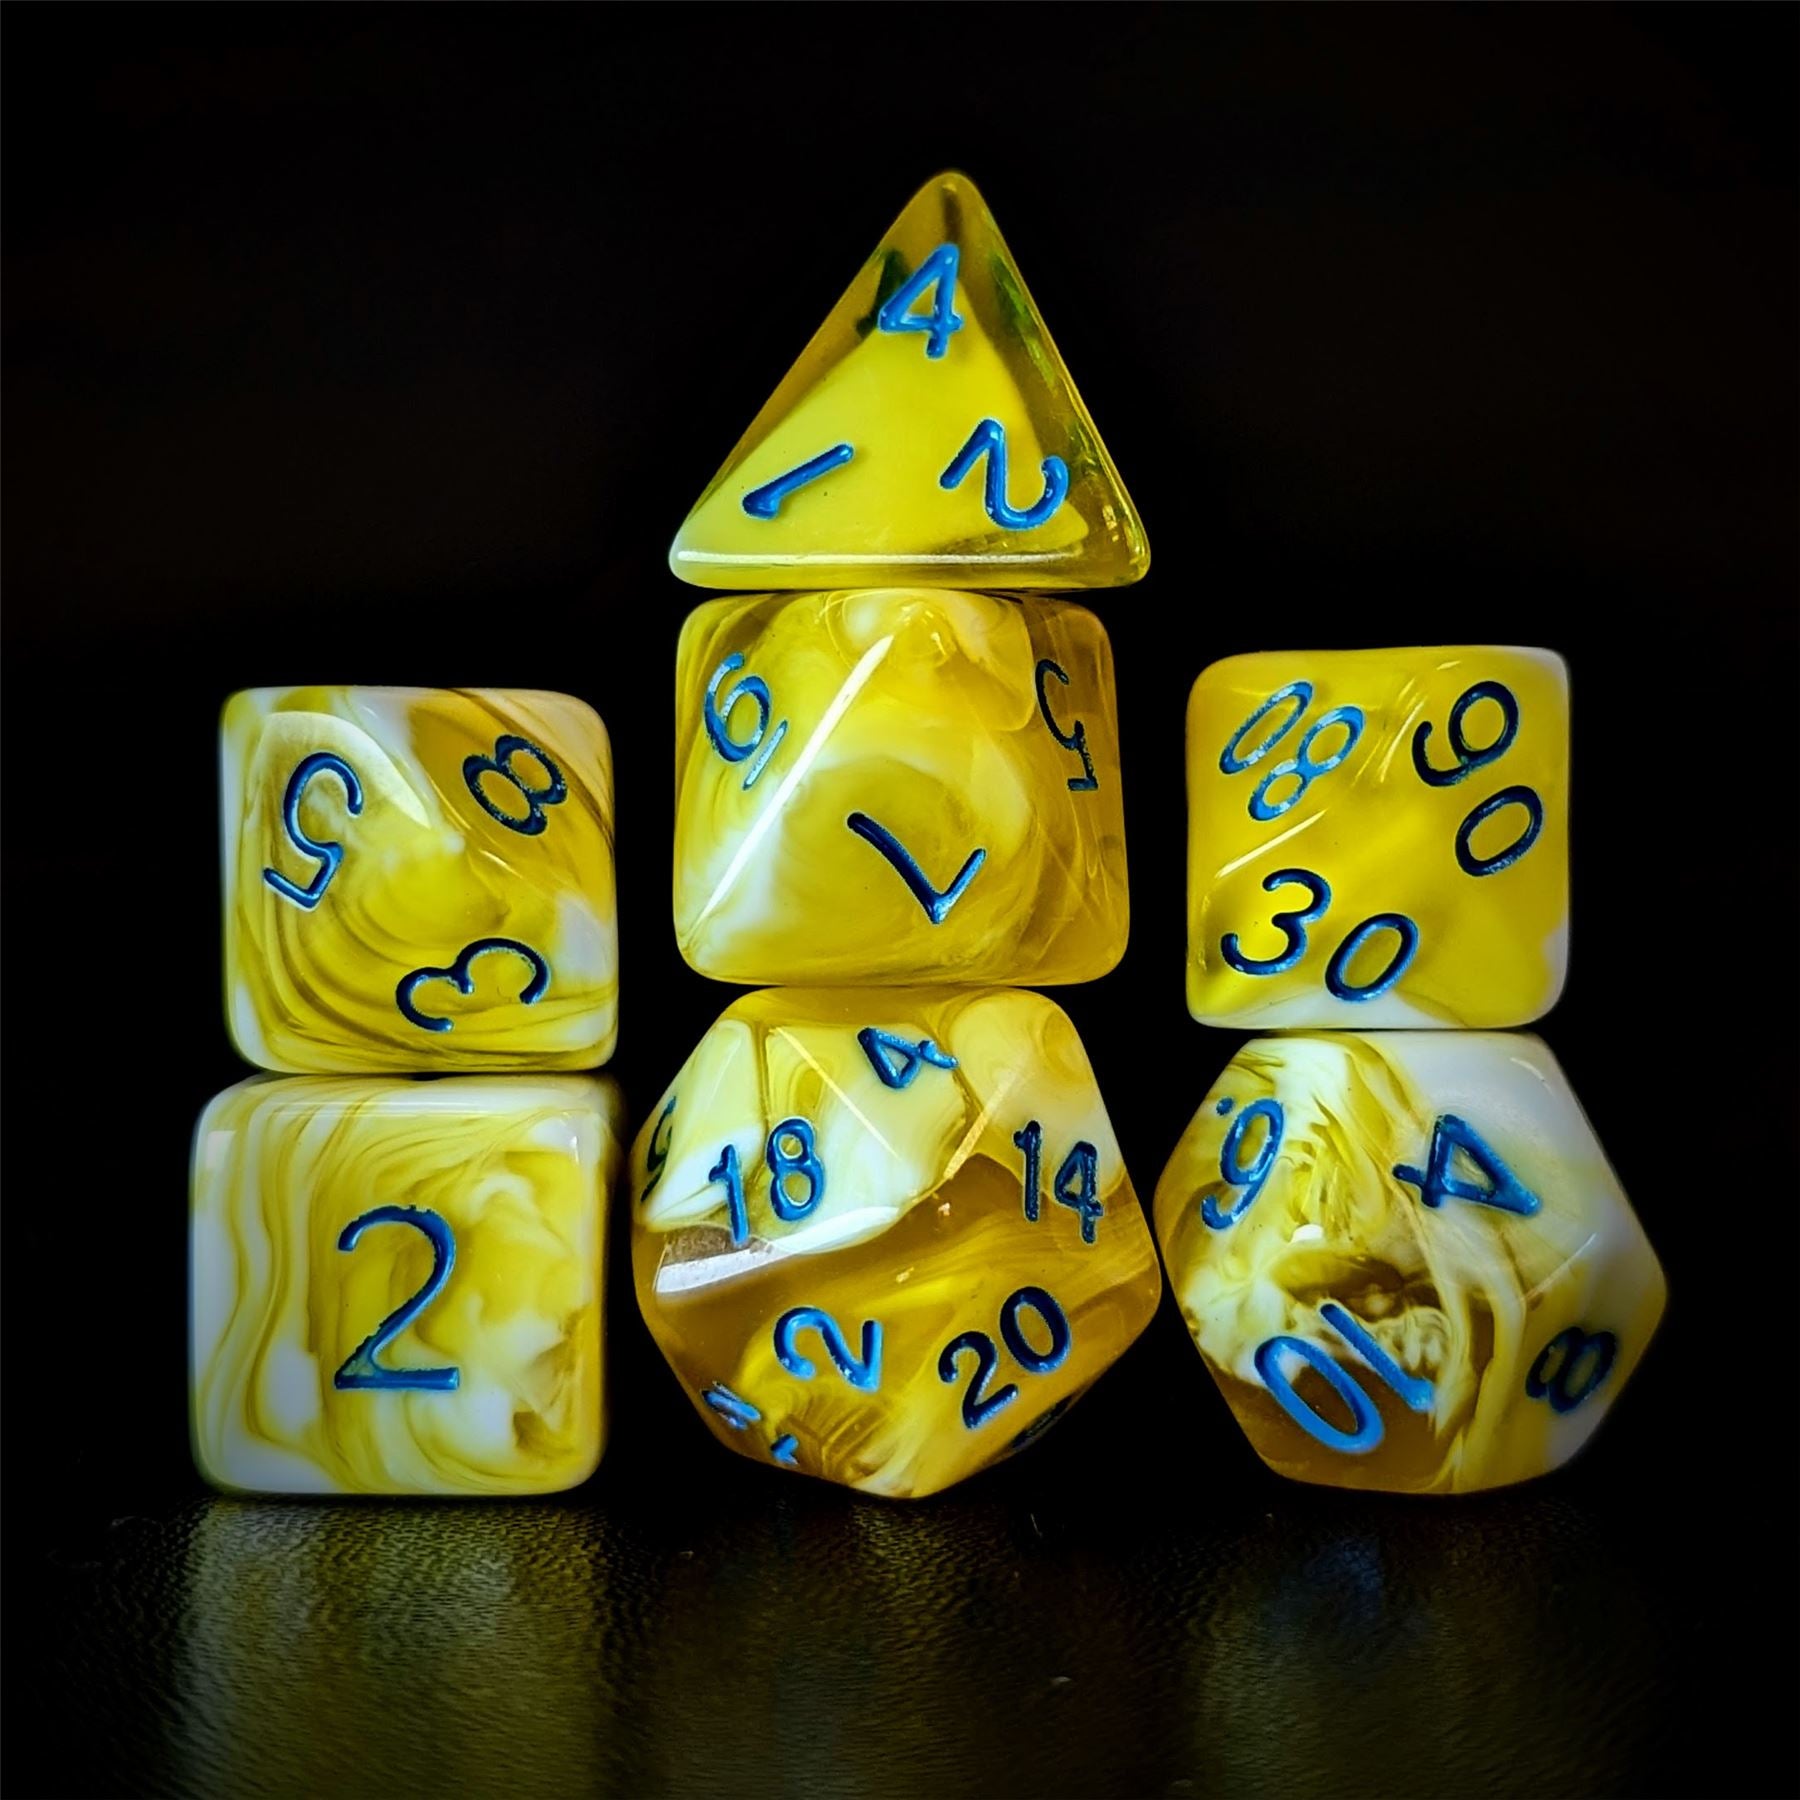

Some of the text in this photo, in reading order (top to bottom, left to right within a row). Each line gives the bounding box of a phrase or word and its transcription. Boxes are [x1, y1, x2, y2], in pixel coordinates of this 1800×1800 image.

[877, 242, 963, 359] 4
[742, 442, 854, 521] 1
[939, 417, 1070, 531] 2
[1034, 658, 1099, 792] 5
[263, 751, 363, 911] 5
[462, 734, 568, 836] 8
[846, 811, 986, 925] 7
[395, 937, 551, 1033] 3
[1220, 867, 1419, 1003] 30
[857, 1027, 959, 1089] 4
[708, 1116, 825, 1244] 18
[1013, 1120, 1104, 1245] 14
[1391, 1113, 1542, 1216] 4
[334, 1204, 460, 1389] 2
[773, 1306, 884, 1394] 2
[937, 1286, 1071, 1430] 20
[1253, 1302, 1437, 1454] 10
[1525, 1325, 1620, 1415] 8
